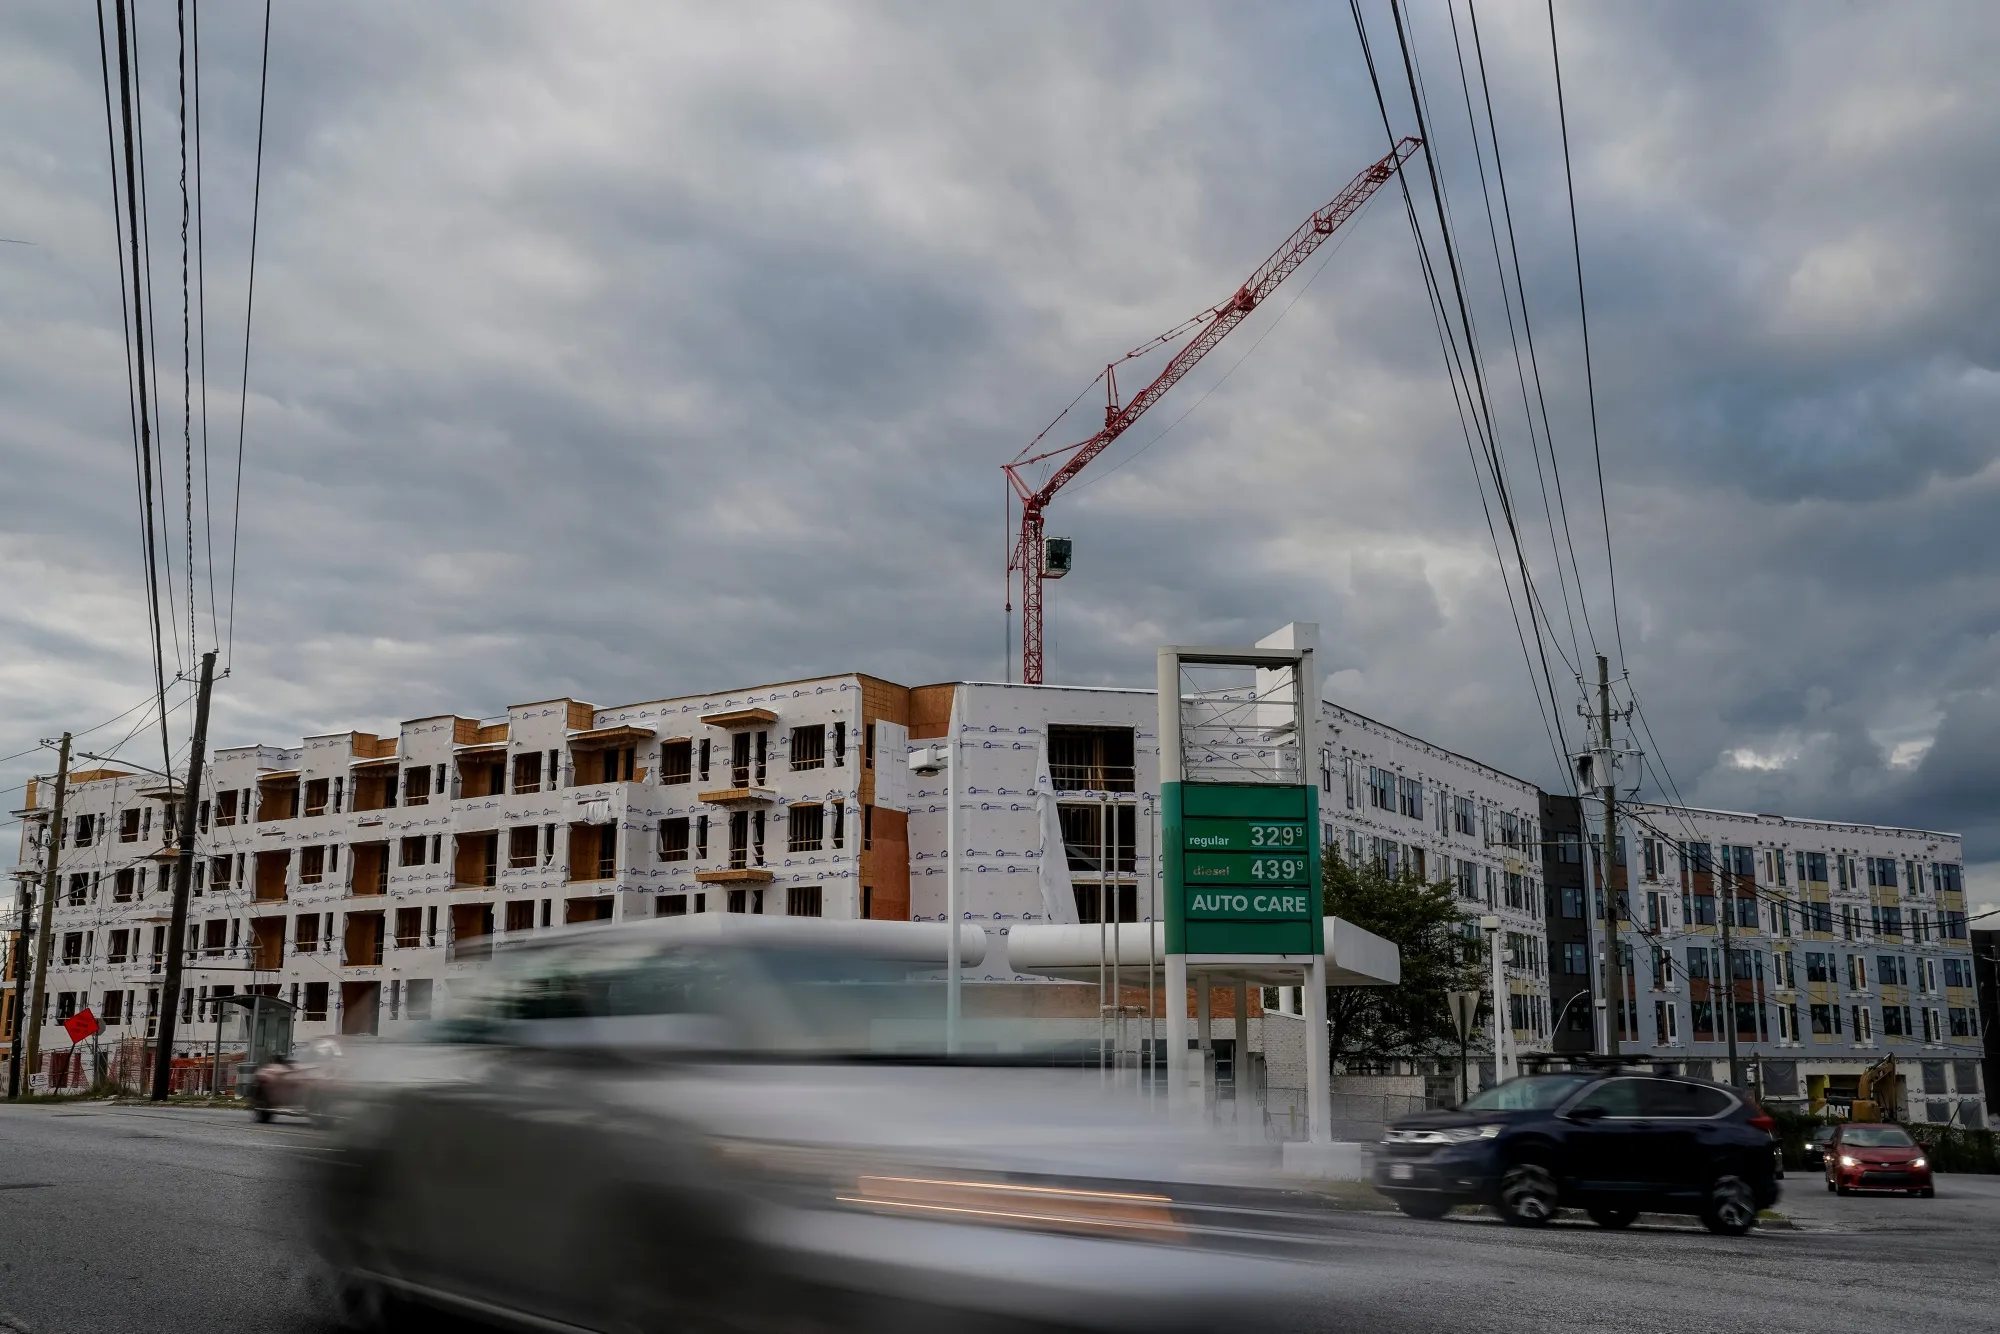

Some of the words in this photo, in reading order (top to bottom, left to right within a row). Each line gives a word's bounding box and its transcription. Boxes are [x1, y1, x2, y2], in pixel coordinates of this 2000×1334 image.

[1190, 836, 1229, 847] regular
[1193, 865, 1230, 875] diesel
[1191, 894, 1249, 912] AUTO
[1253, 895, 1307, 913] CARE
